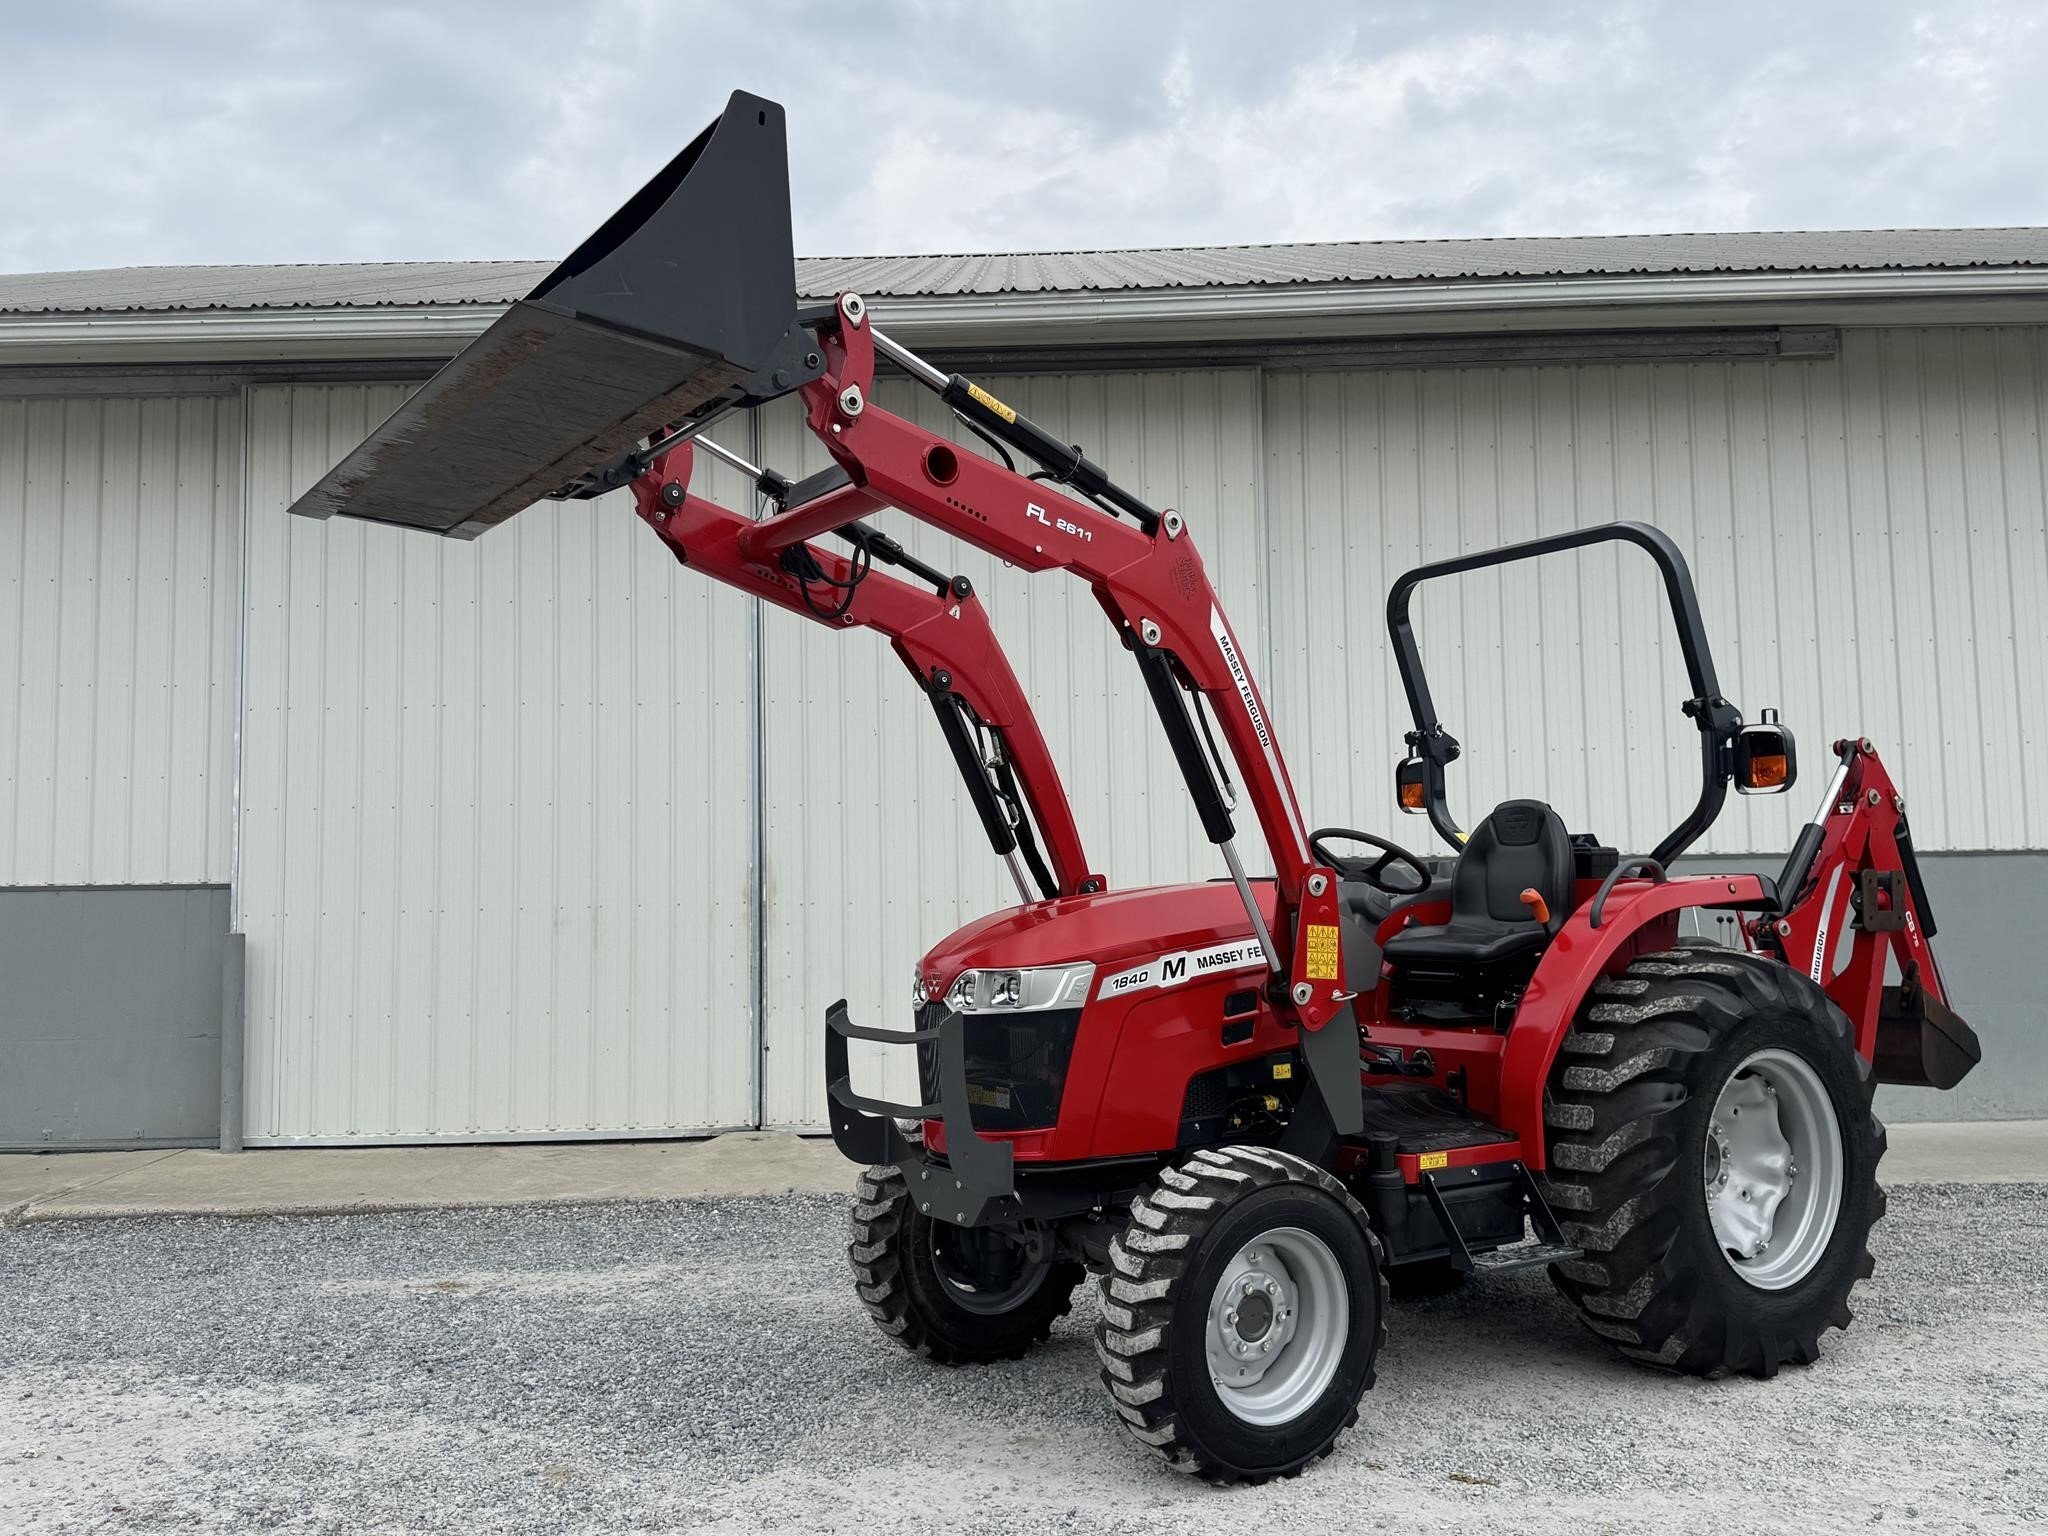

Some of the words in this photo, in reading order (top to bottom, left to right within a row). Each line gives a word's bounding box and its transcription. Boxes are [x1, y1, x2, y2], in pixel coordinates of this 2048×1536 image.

[1026, 502, 1051, 527] FL
[1056, 518, 1092, 542] 2611
[1219, 635, 1245, 683] MASSEY
[1241, 685, 1270, 748] FERGUSON
[1112, 971, 1149, 990] 1840
[1161, 956, 1186, 981] M
[1196, 949, 1244, 969] MASSEY
